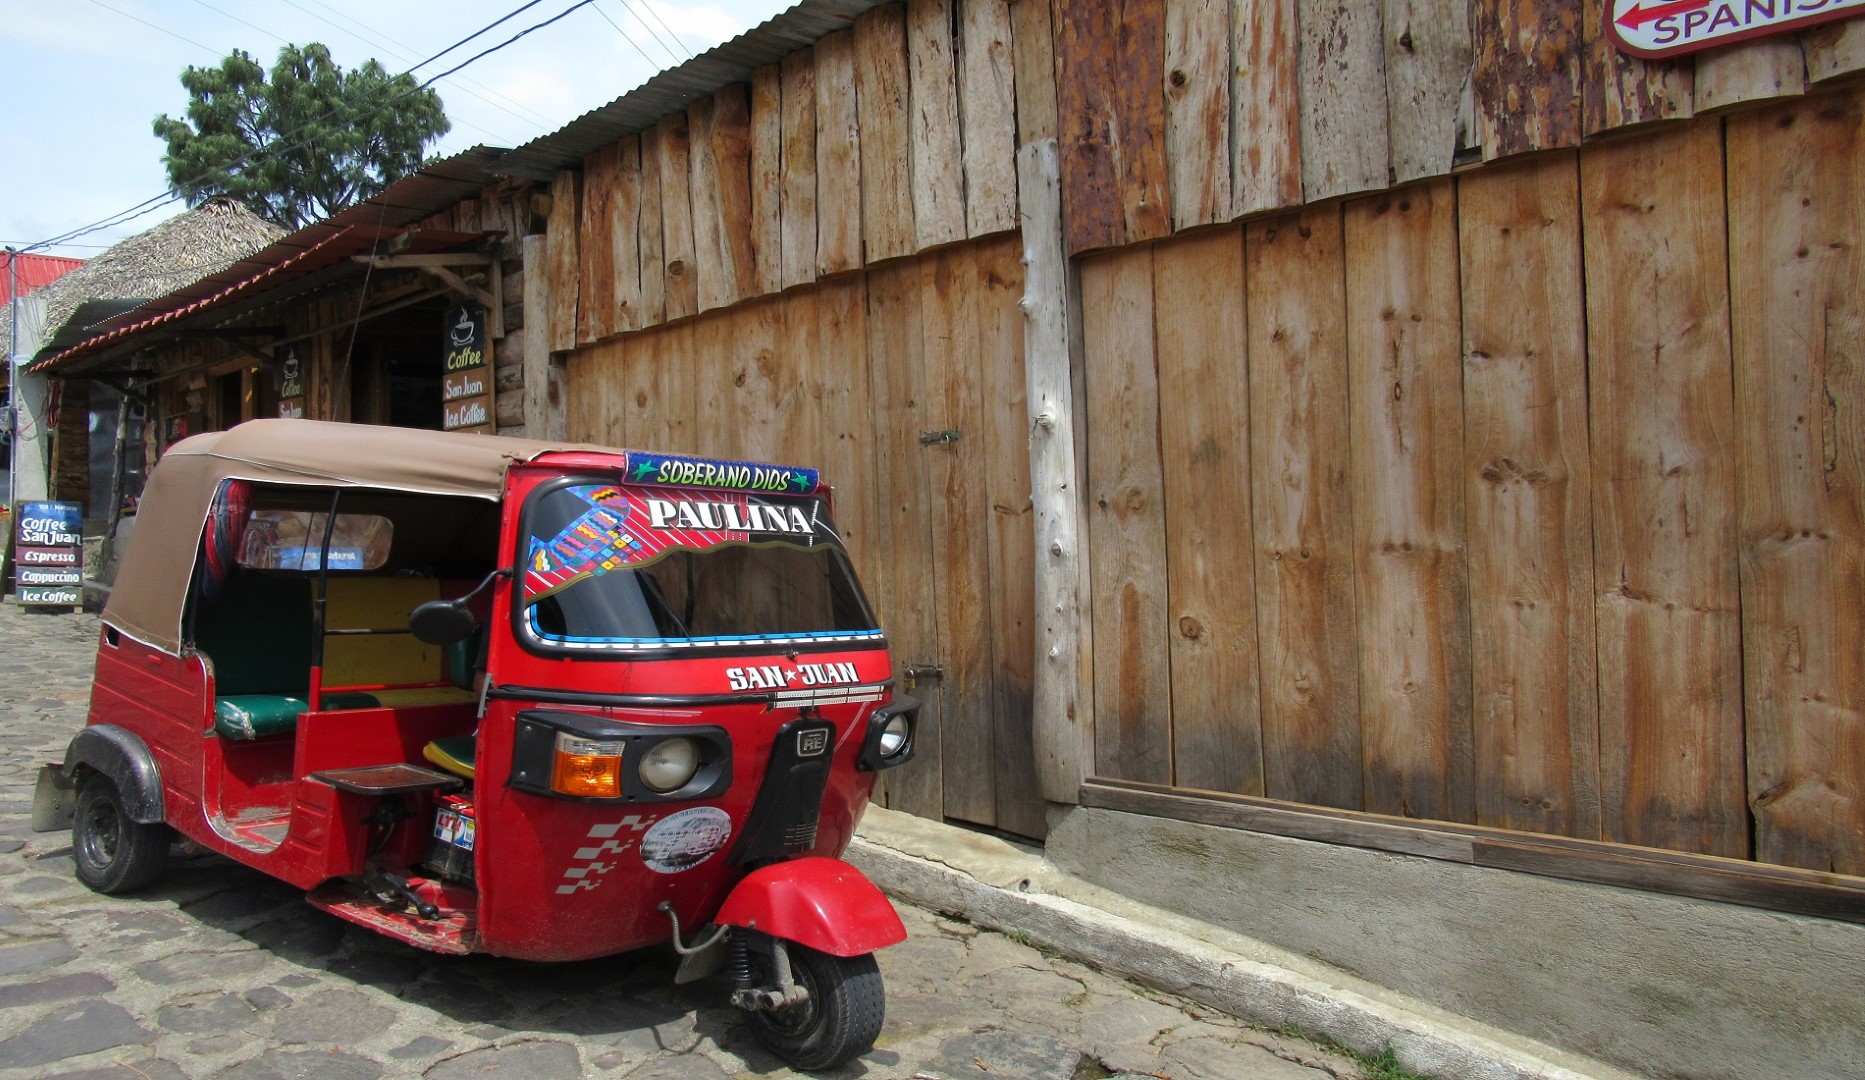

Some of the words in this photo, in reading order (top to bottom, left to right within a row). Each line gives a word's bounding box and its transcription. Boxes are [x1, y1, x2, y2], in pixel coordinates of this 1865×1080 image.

[448, 346, 481, 370] Coffee
[446, 379, 462, 399] San
[463, 375, 482, 396] Juan
[446, 409, 459, 427] Ice
[460, 403, 486, 425] Coffee
[656, 460, 750, 488] SOBERANO
[751, 467, 791, 491] DIOS
[21, 517, 67, 532] Coffee
[645, 499, 815, 534] PAULINA
[25, 551, 76, 563] Espresso
[21, 570, 80, 584] Cappuccino
[22, 590, 41, 602] Ice
[42, 591, 77, 604] Coffee
[726, 665, 788, 691] SAN
[796, 662, 859, 685] JUAN
[803, 738, 822, 751] RE
